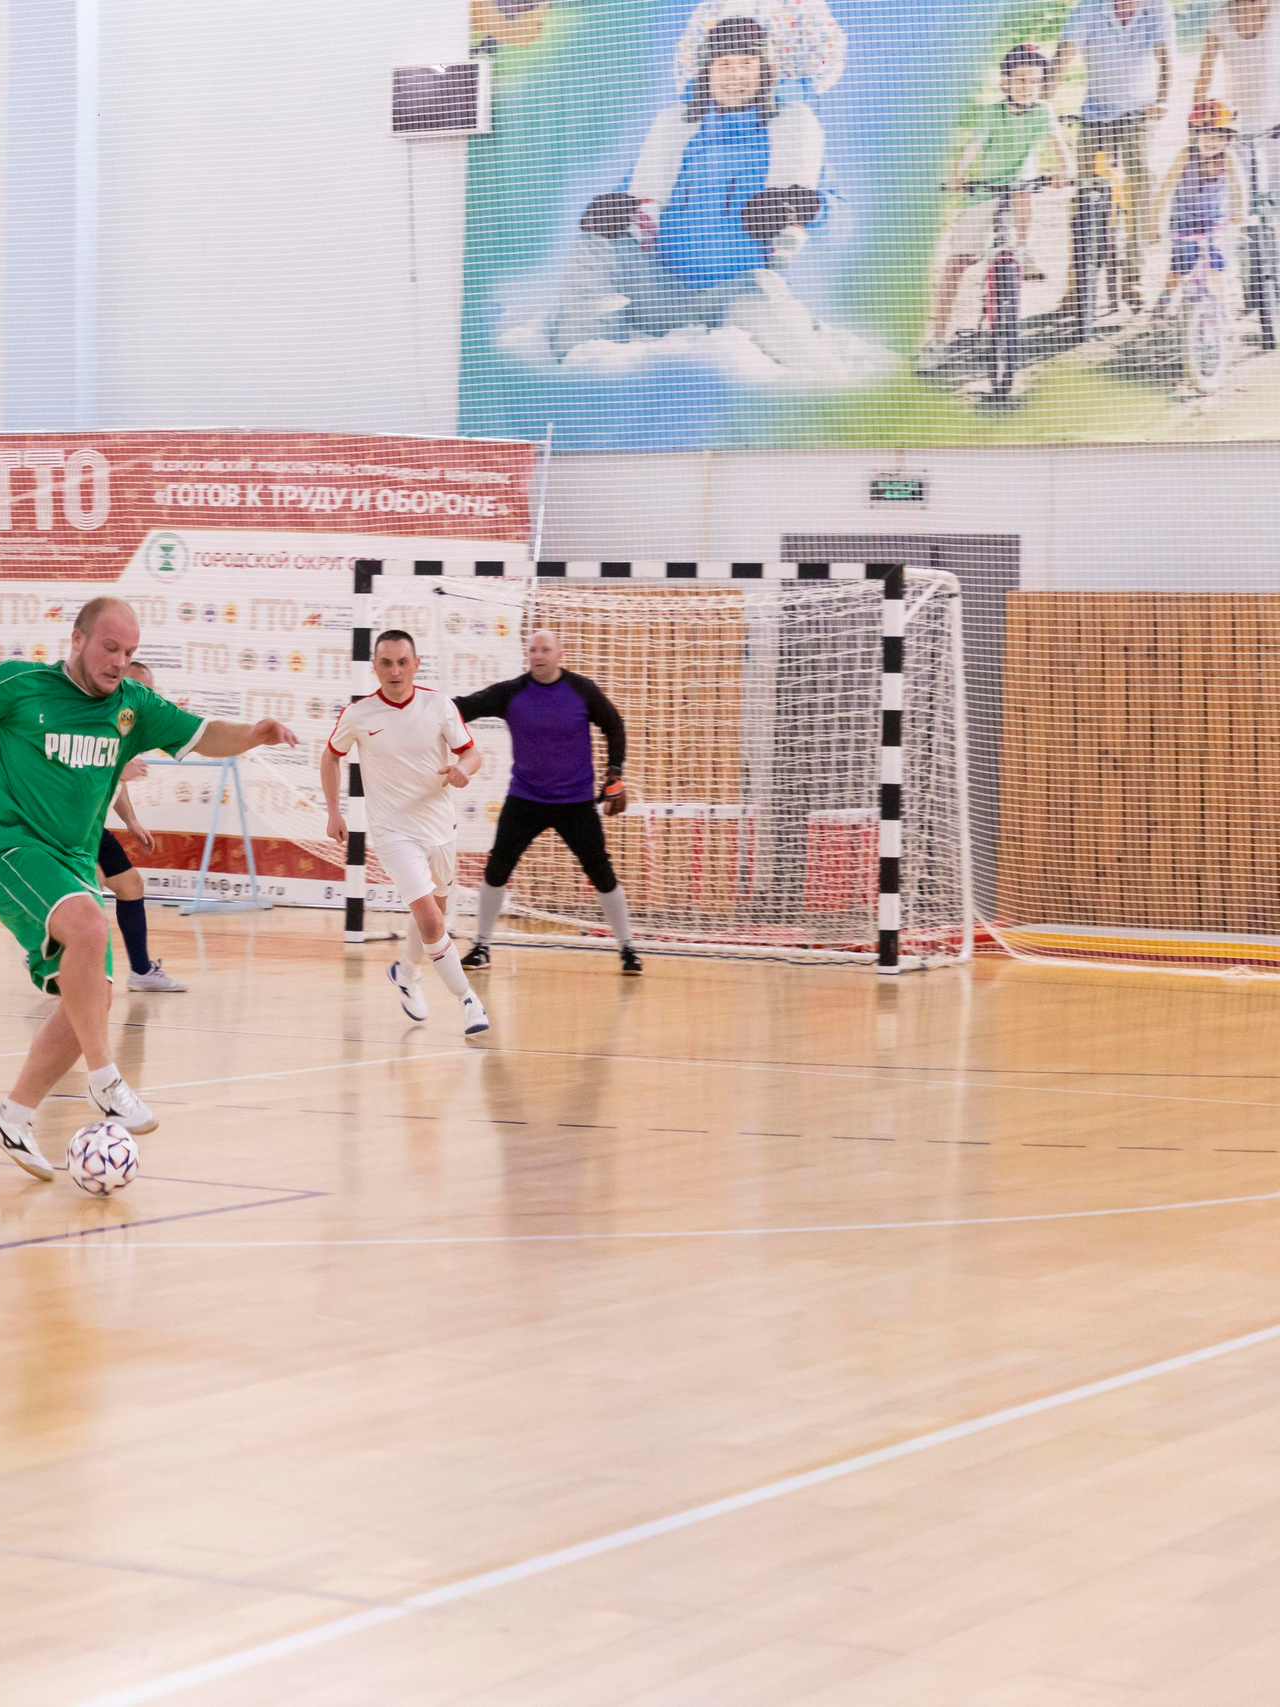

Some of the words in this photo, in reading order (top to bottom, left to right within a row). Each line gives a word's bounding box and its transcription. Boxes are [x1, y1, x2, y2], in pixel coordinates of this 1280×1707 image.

[153, 484, 240, 507] «ГОТОВ
[245, 484, 264, 507] К
[268, 485, 349, 513] ТРУДУ
[351, 488, 370, 511] И
[375, 489, 509, 517] ОБОРОНЕ»
[192, 551, 290, 570] ГОРОДСКОЙ
[293, 555, 345, 571] ОКРУГ
